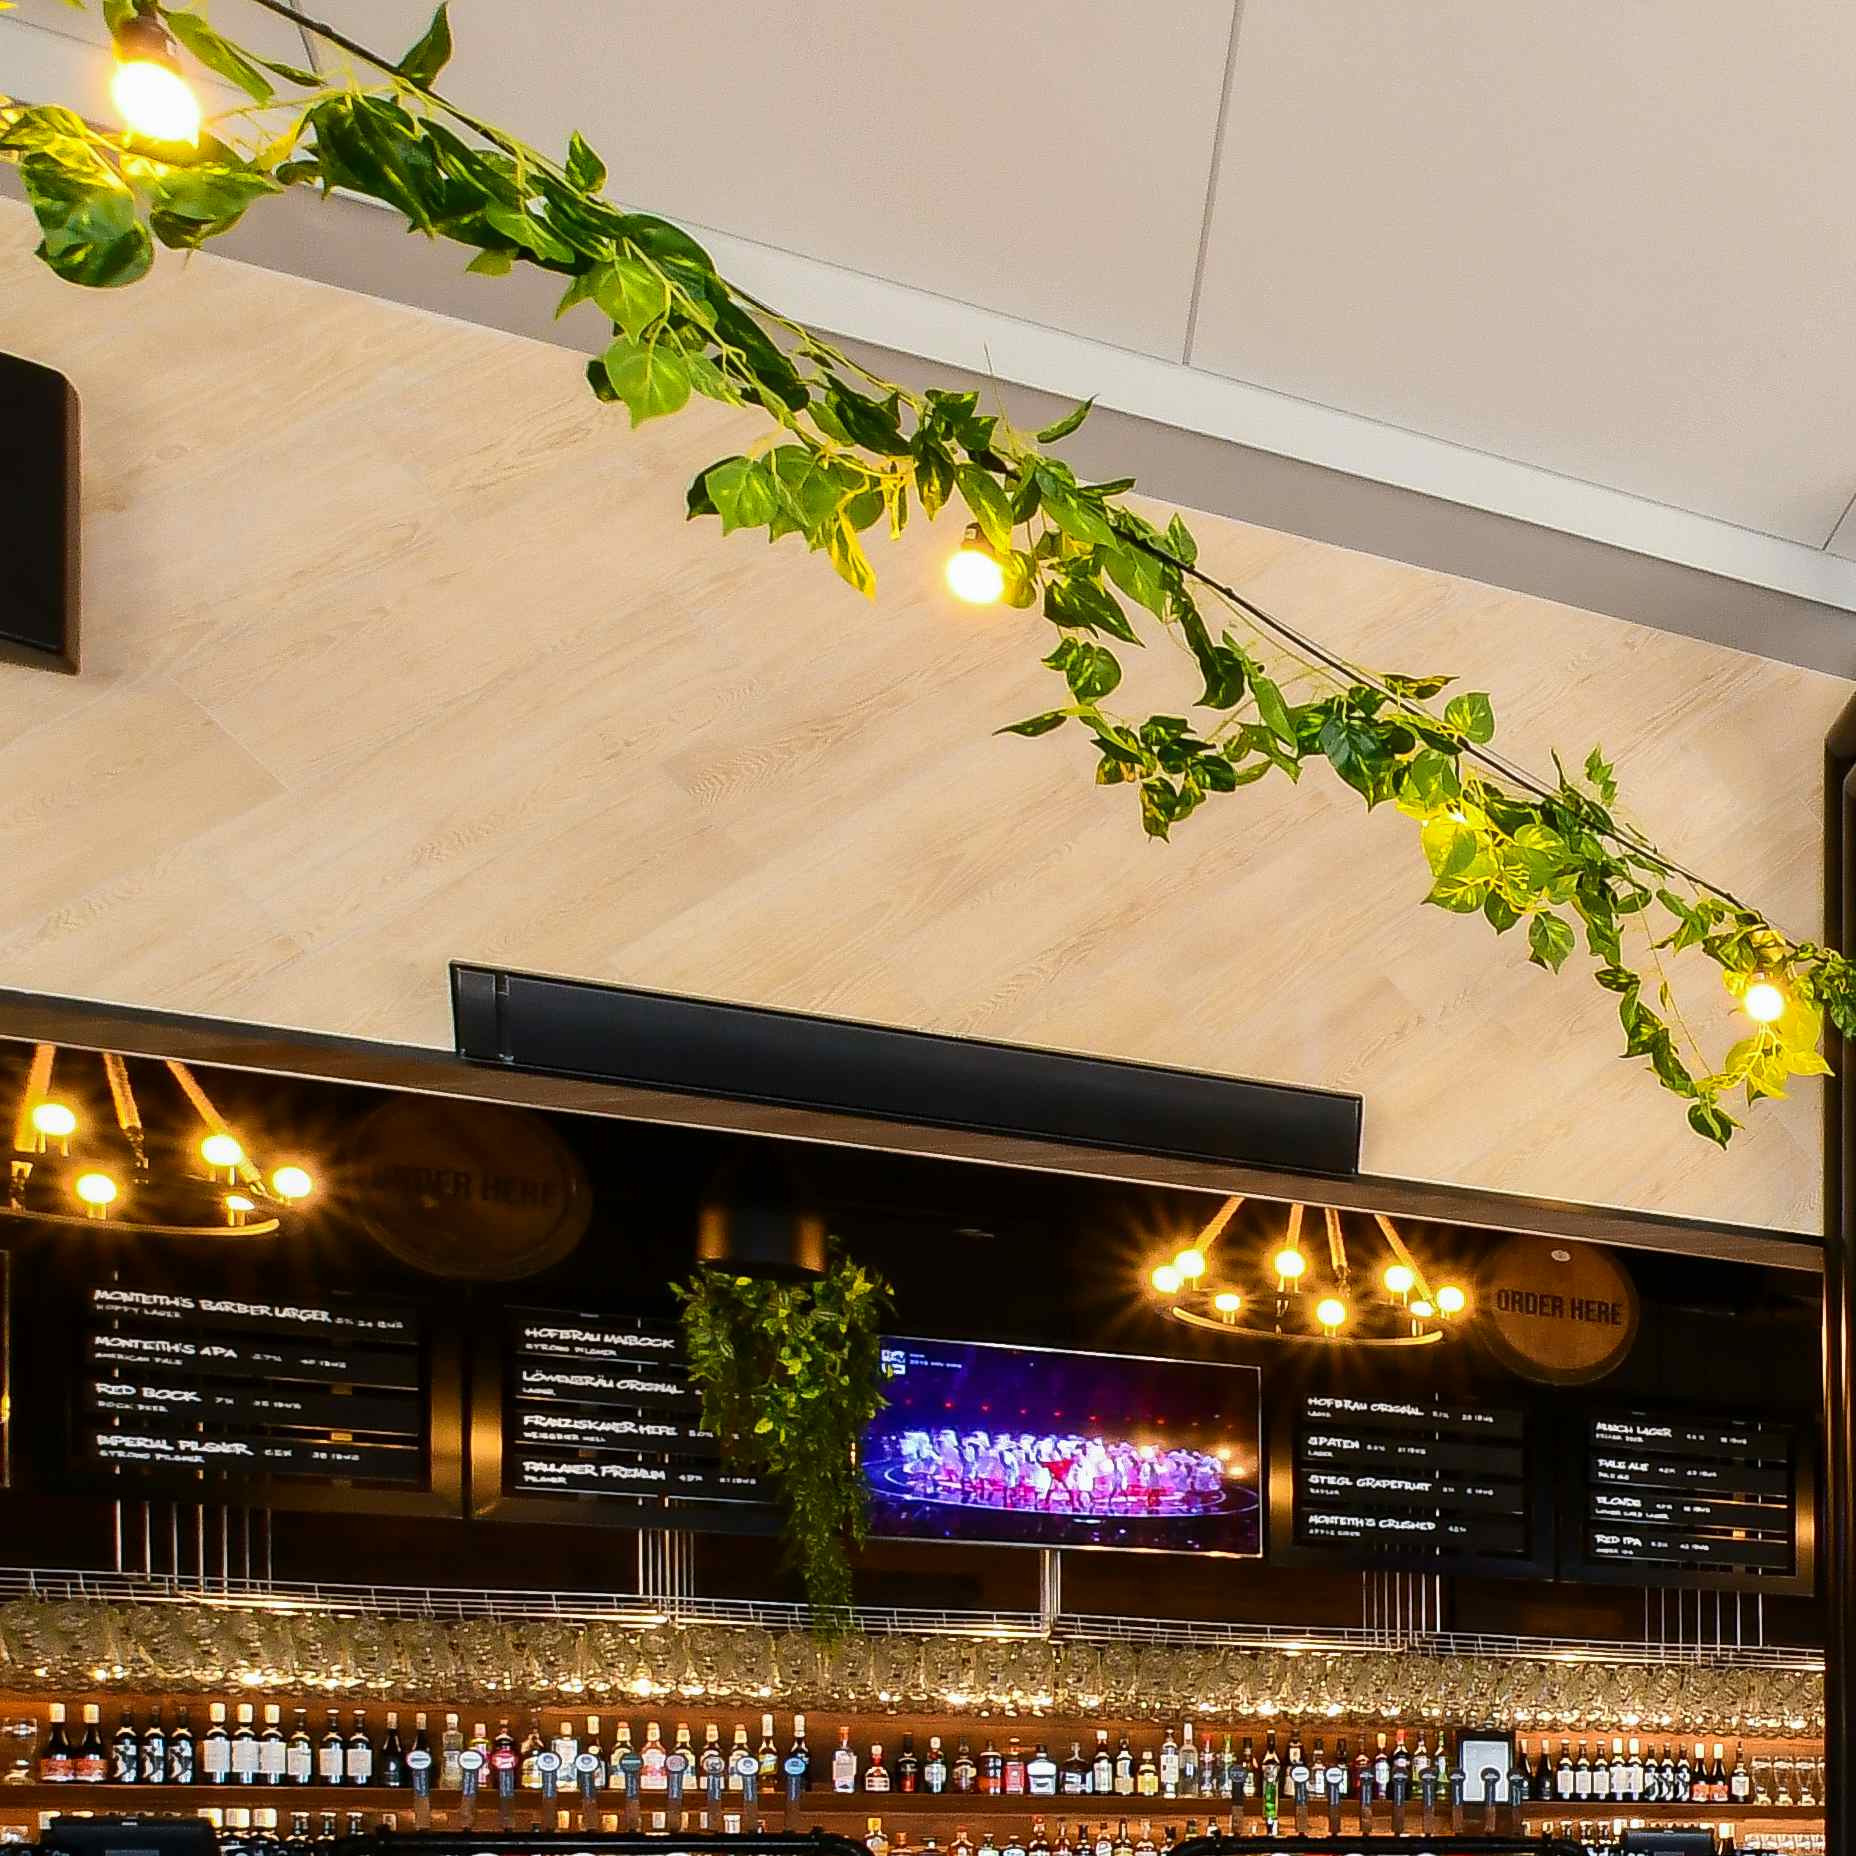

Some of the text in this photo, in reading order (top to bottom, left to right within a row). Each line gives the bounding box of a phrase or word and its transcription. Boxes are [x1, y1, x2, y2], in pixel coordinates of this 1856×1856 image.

[93, 1289, 195, 1309] MONTEITH'S
[199, 1299, 273, 1318] BARBER
[1497, 1289, 1622, 1325] ORDER HERE
[94, 1336, 196, 1355] MONTEITH'S
[200, 1346, 238, 1359] APA
[95, 1382, 136, 1397] RED
[142, 1387, 202, 1402] BOCK
[617, 1379, 684, 1394] ORIGINAL
[523, 1415, 637, 1434] FRANZISKANER
[639, 1424, 678, 1437] HEFE
[1636, 1425, 1672, 1438] LAGER
[96, 1434, 175, 1451] IMPERIAL
[178, 1440, 254, 1456] PILSNER
[1308, 1437, 1360, 1449] SPATEN
[1628, 1462, 1649, 1472] ALE
[1308, 1474, 1353, 1486] STIEGL
[1356, 1477, 1432, 1492] GRAPEFRUIT
[1308, 1514, 1376, 1528] MONTEITH'S
[1378, 1519, 1436, 1531] CRUSHED
[1622, 1537, 1642, 1547] IPA
